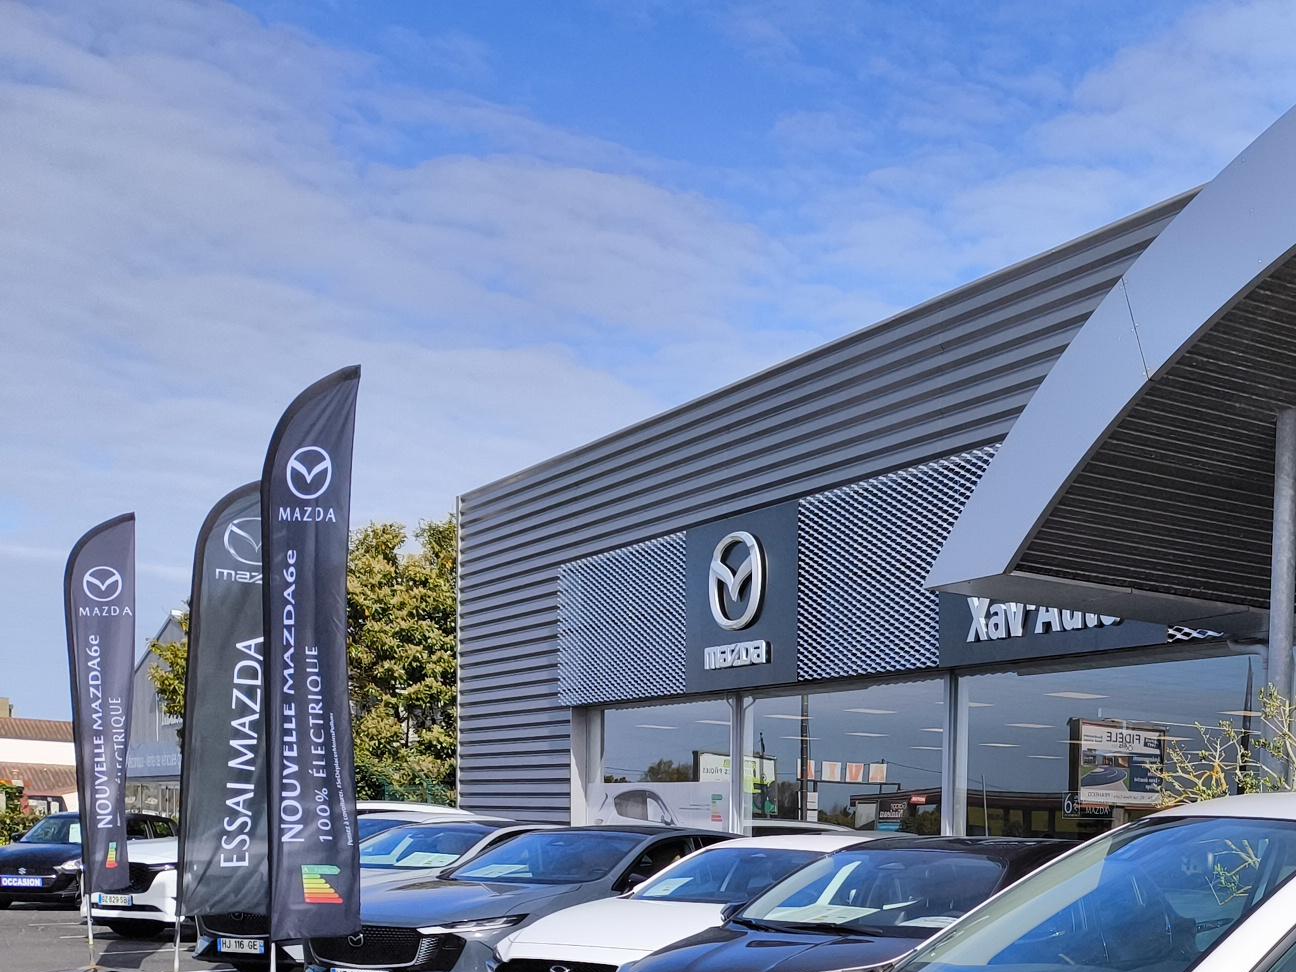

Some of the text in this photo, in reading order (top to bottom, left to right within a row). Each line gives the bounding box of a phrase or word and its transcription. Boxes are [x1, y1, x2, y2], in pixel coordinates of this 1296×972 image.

[278, 507, 337, 523] MAZDA
[215, 568, 263, 584] maz
[79, 606, 133, 617] MAZDA
[703, 639, 768, 671] mazda
[281, 550, 305, 842] NOUVELLE MAZDA6e
[86, 634, 113, 829] NOUVELLE MAZDA6e
[306, 646, 333, 843] 100% ÉLECTRIQUE
[220, 637, 265, 868] ESSAI MAZDA
[1, 878, 43, 887] OCCASION
